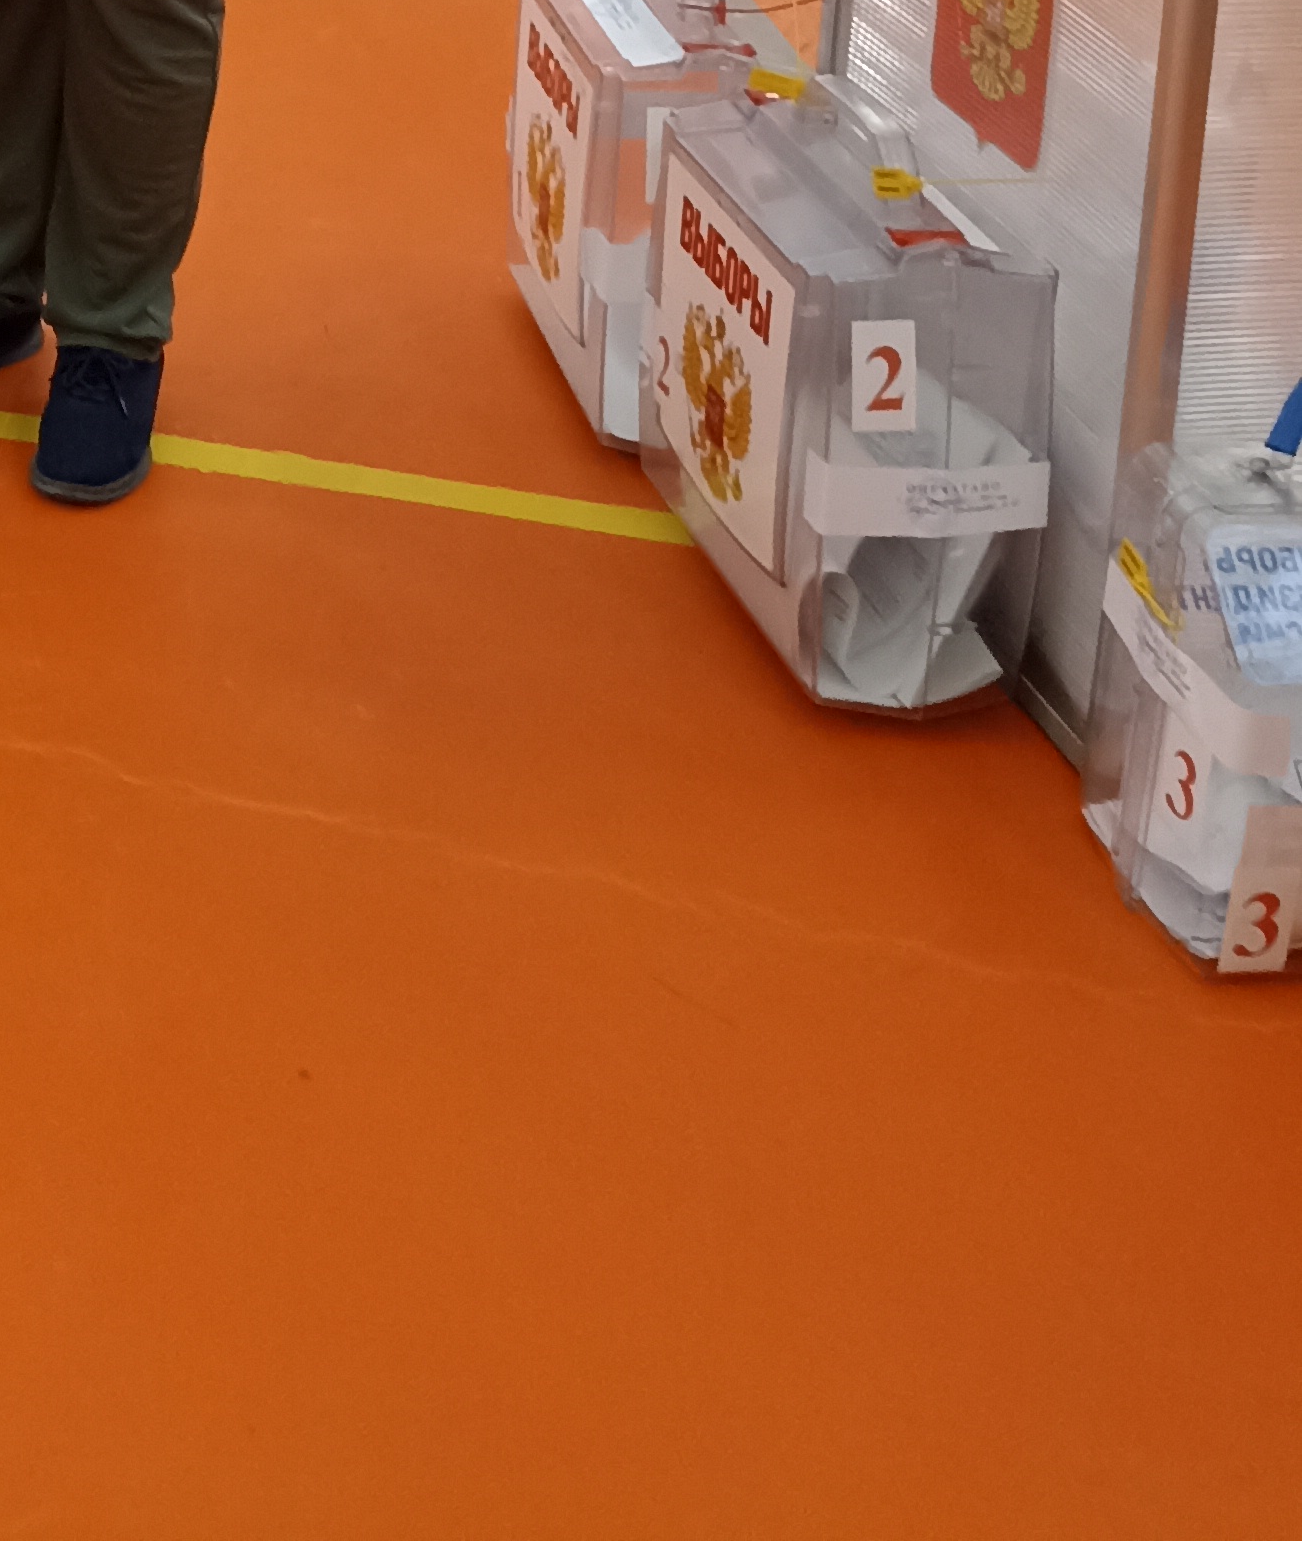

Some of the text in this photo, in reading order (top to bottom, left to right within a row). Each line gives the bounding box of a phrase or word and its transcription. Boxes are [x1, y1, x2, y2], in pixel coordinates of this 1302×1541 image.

[679, 195, 773, 347] ВЫБОРЫ
[864, 345, 906, 412] 2
[1165, 749, 1197, 821] 3
[1232, 892, 1281, 958] 3
